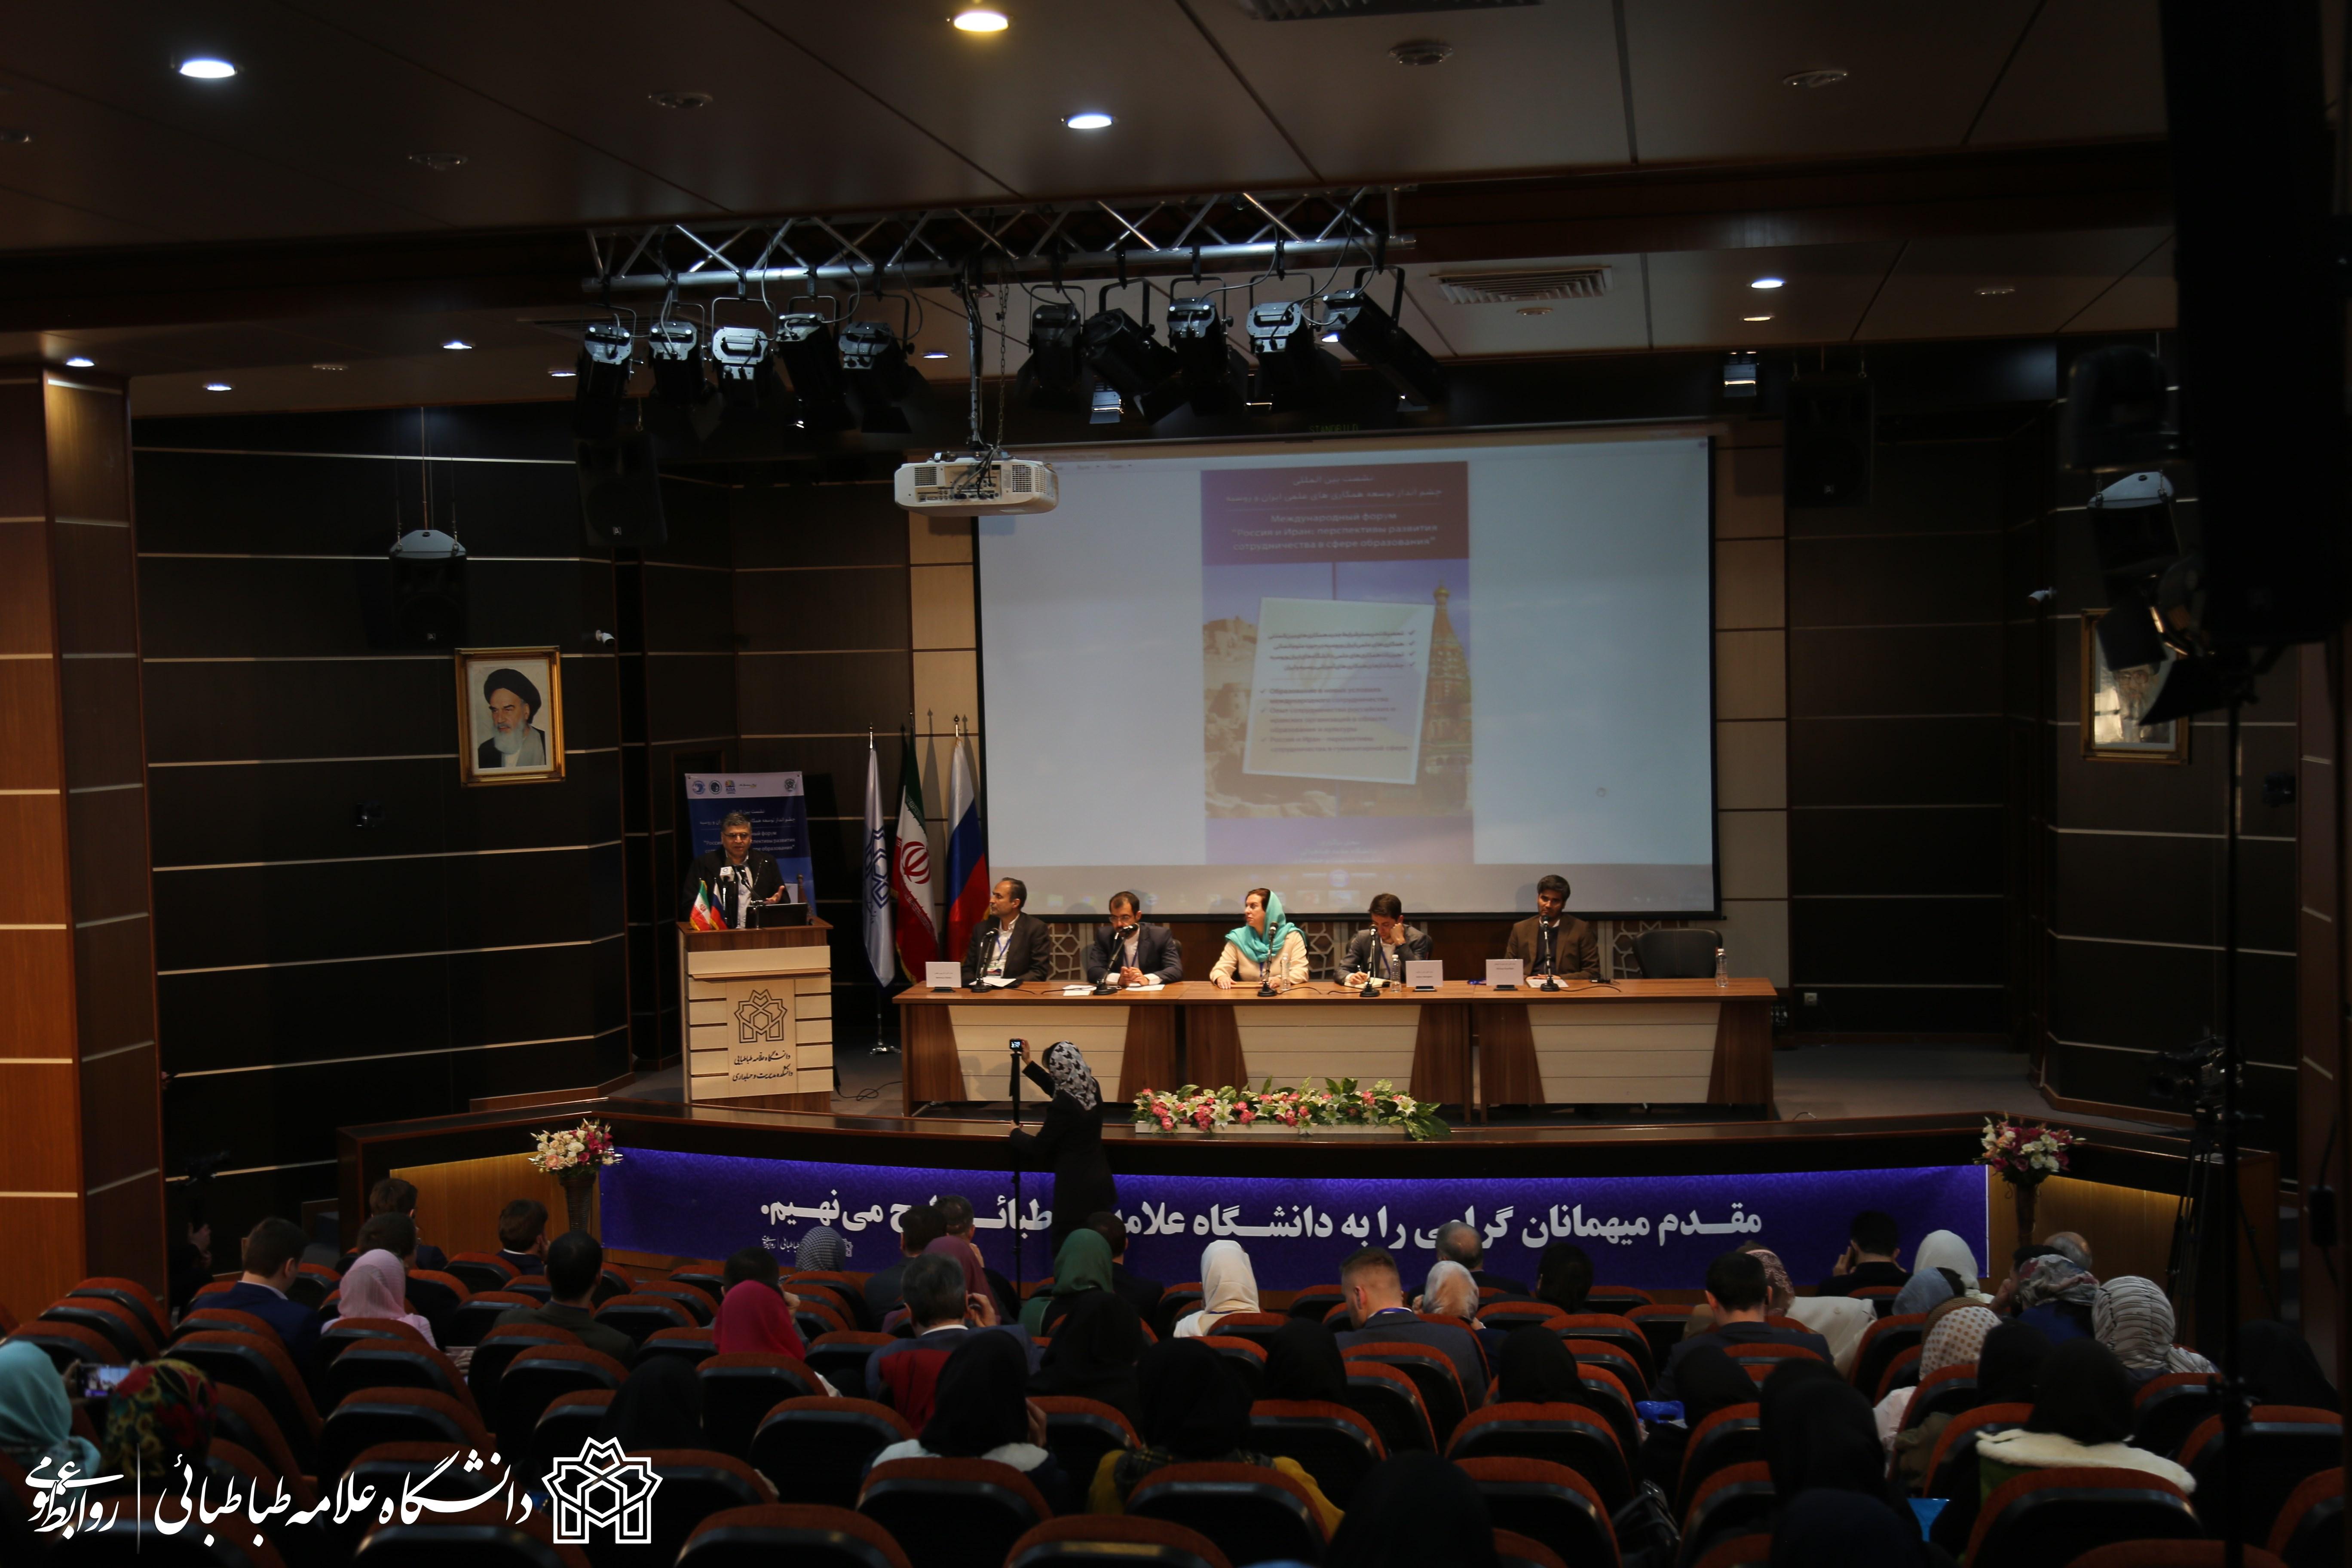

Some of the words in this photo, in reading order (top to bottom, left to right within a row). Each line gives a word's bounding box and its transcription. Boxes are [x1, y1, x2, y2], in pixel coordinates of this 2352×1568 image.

[1293, 475, 1322, 486] المللی
[1325, 477, 1340, 485] بین
[1225, 494, 1253, 503] روسیه
[1261, 493, 1282, 502] ایران
[1284, 492, 1308, 502] علمی
[1312, 492, 1328, 500] های
[1330, 490, 1364, 500] همکاری
[1271, 513, 1360, 524] Международный
[1363, 512, 1397, 523] форум
[1317, 526, 1387, 536] перспективы
[1388, 524, 1438, 535] развития
[1233, 542, 1316, 552] сотрудничества
[1326, 539, 1358, 550] сфере
[765, 1050, 790, 1062] دانشگاه
[777, 1063, 793, 1078] دانشکده
[1193, 1204, 1333, 1237] دانشگاه
[1522, 1204, 1650, 1248] میهمانان
[1659, 1202, 1762, 1246] مقدم
[1341, 1213, 1370, 1247] به
[1377, 1205, 1407, 1249] را
[1414, 1205, 1514, 1249] گرای
